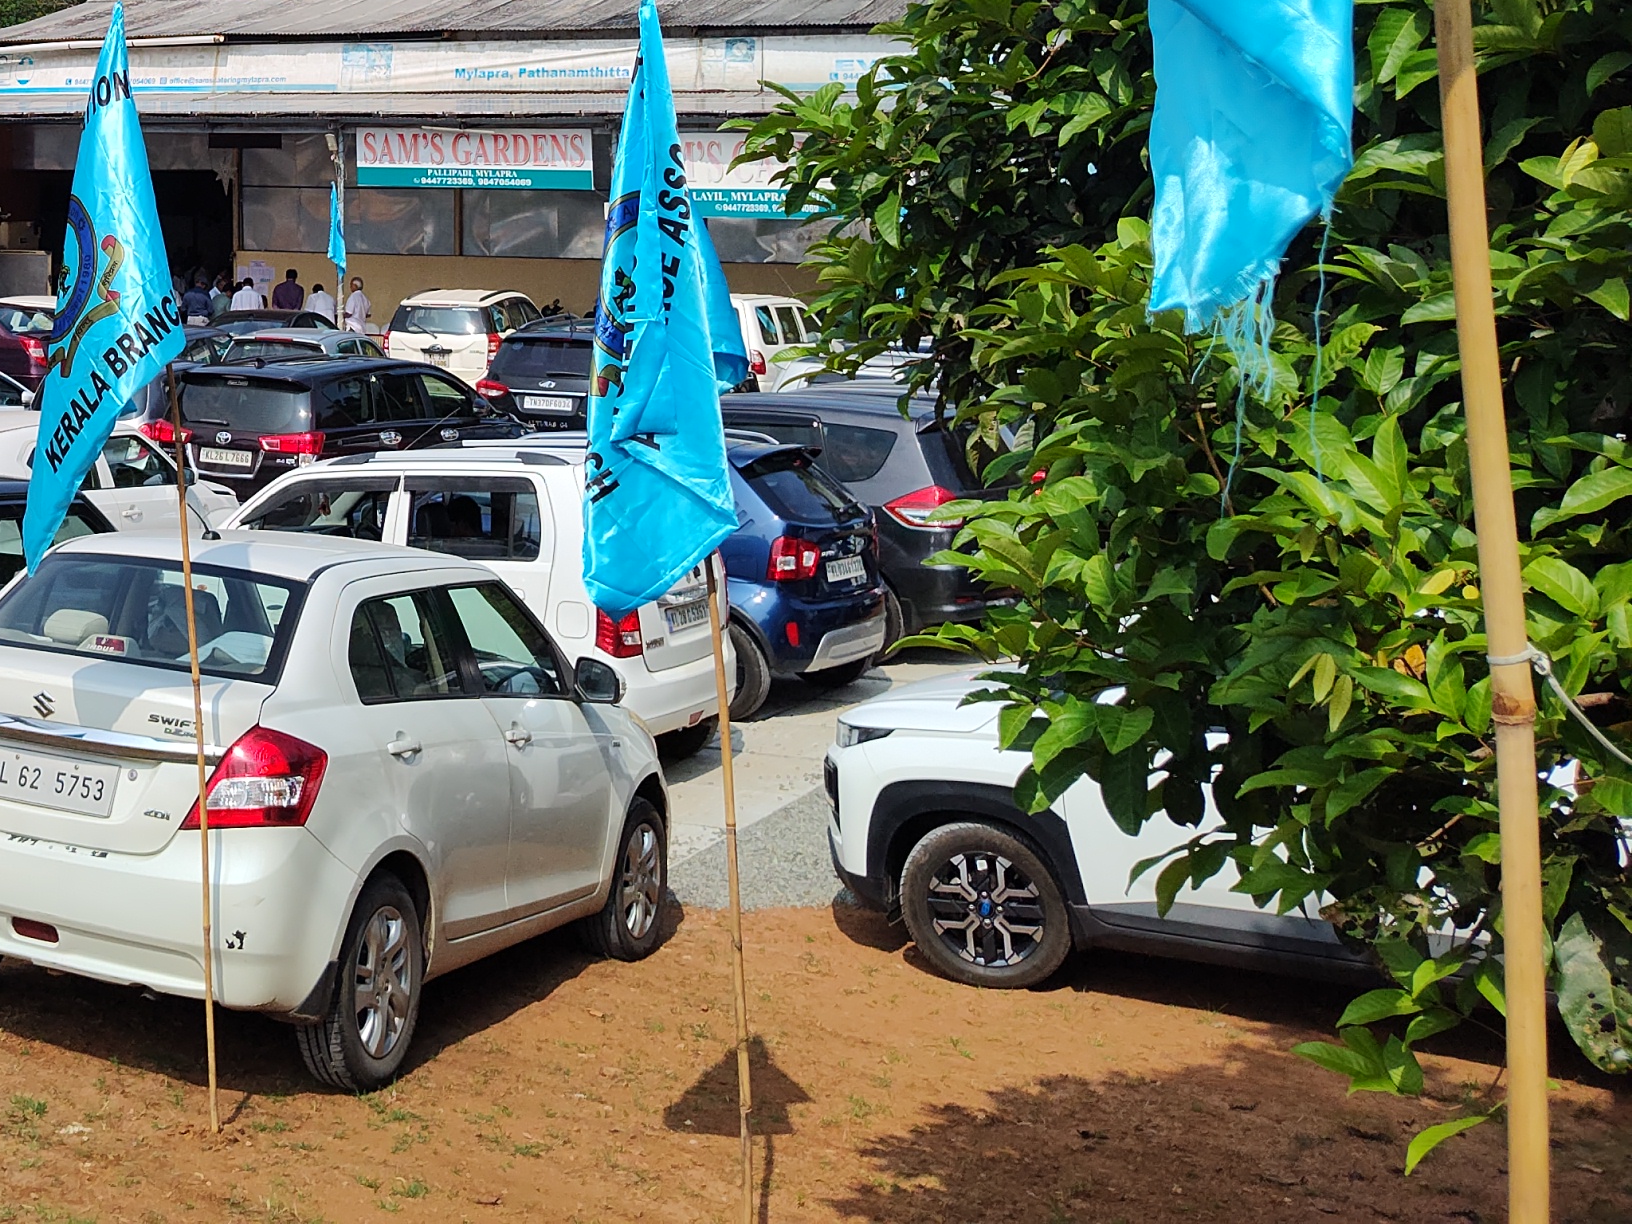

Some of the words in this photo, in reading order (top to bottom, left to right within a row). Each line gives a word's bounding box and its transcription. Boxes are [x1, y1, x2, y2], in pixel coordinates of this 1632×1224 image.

[454, 67, 514, 82] Mylapra,
[519, 66, 631, 79] Pathanamthitta
[363, 132, 445, 166] SAM'S
[451, 132, 586, 167] GARDENS
[475, 170, 518, 178] MYLAPRA
[81, 254, 92, 286] 1980
[44, 369, 112, 474] KERALA
[18, 766, 42, 790] 62
[54, 772, 105, 801] 5753
